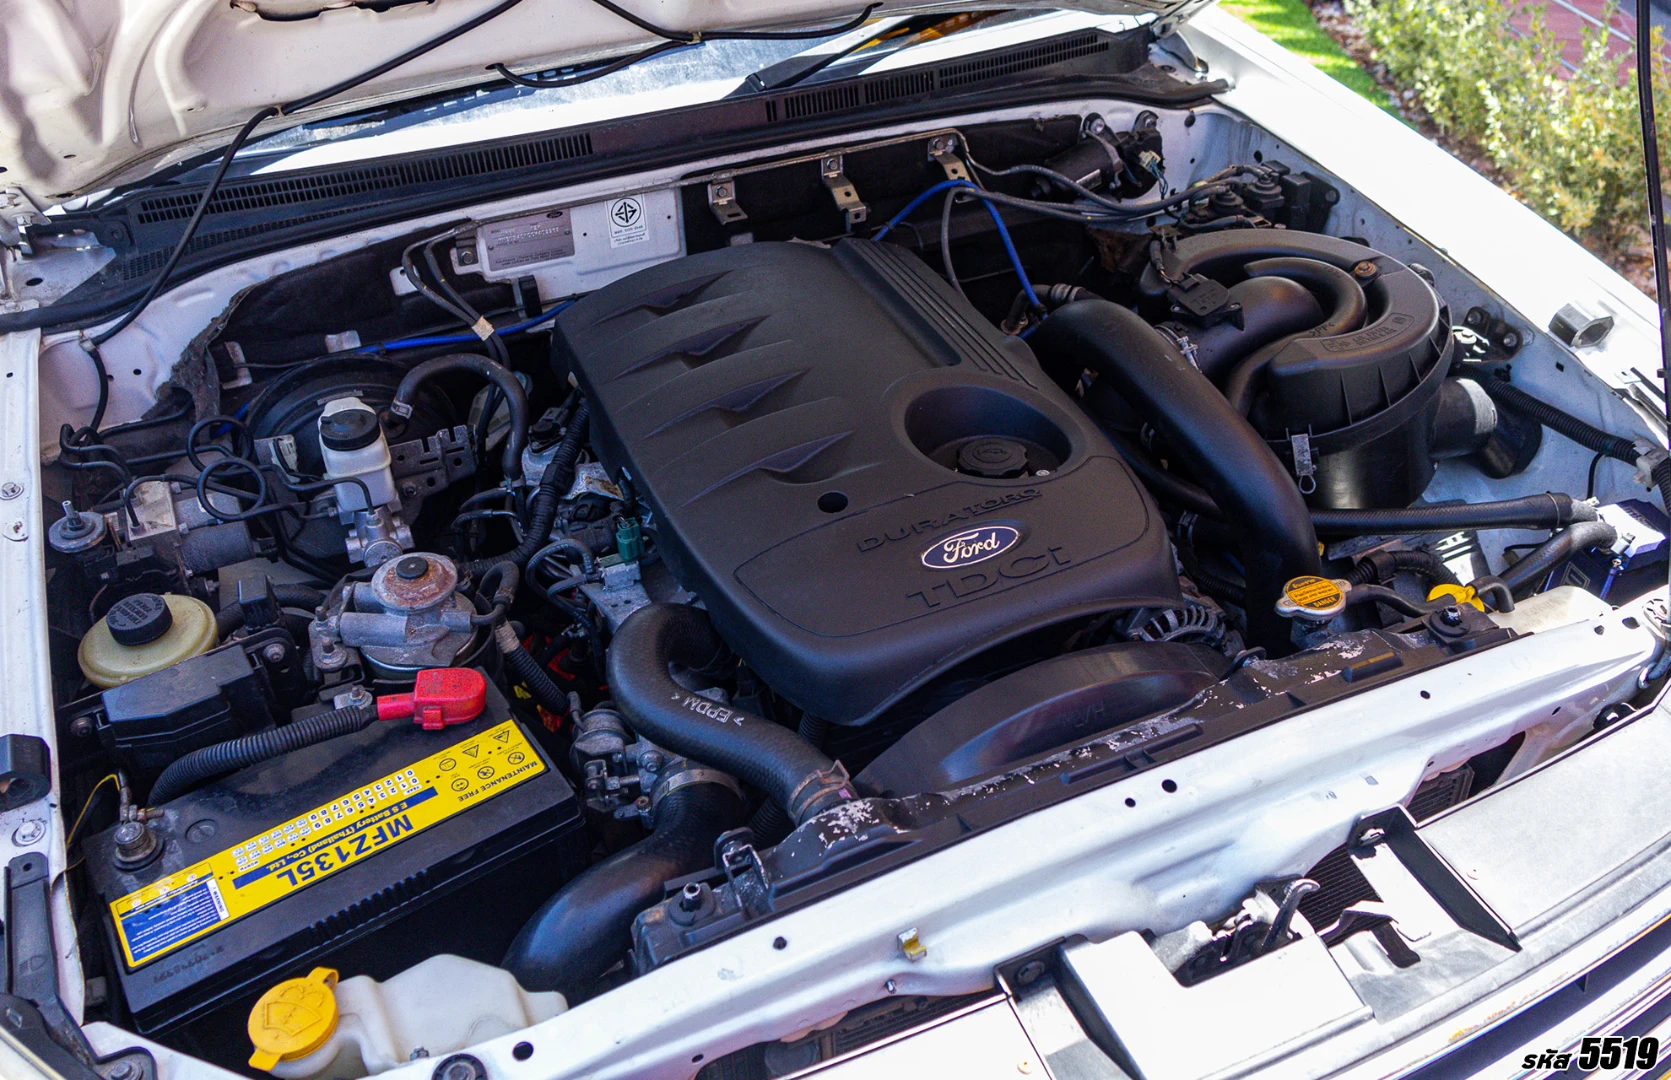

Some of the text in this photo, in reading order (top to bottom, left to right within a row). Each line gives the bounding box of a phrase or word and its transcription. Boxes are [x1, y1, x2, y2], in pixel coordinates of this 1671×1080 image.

[857, 489, 1043, 553] DURATORQ
[943, 532, 1001, 563] Ford
[1313, 596, 1336, 607] DANGER
[682, 695, 733, 723] EPDM
[478, 760, 538, 791] MAINTENANCE
[405, 785, 420, 793] YEAR
[456, 787, 479, 802] FREE
[390, 804, 399, 813] S
[398, 801, 408, 809] E
[354, 807, 391, 830] Battery
[276, 814, 414, 888] MFZ135L
[305, 825, 356, 854] (Thailand)
[265, 858, 286, 871] Ltd.
